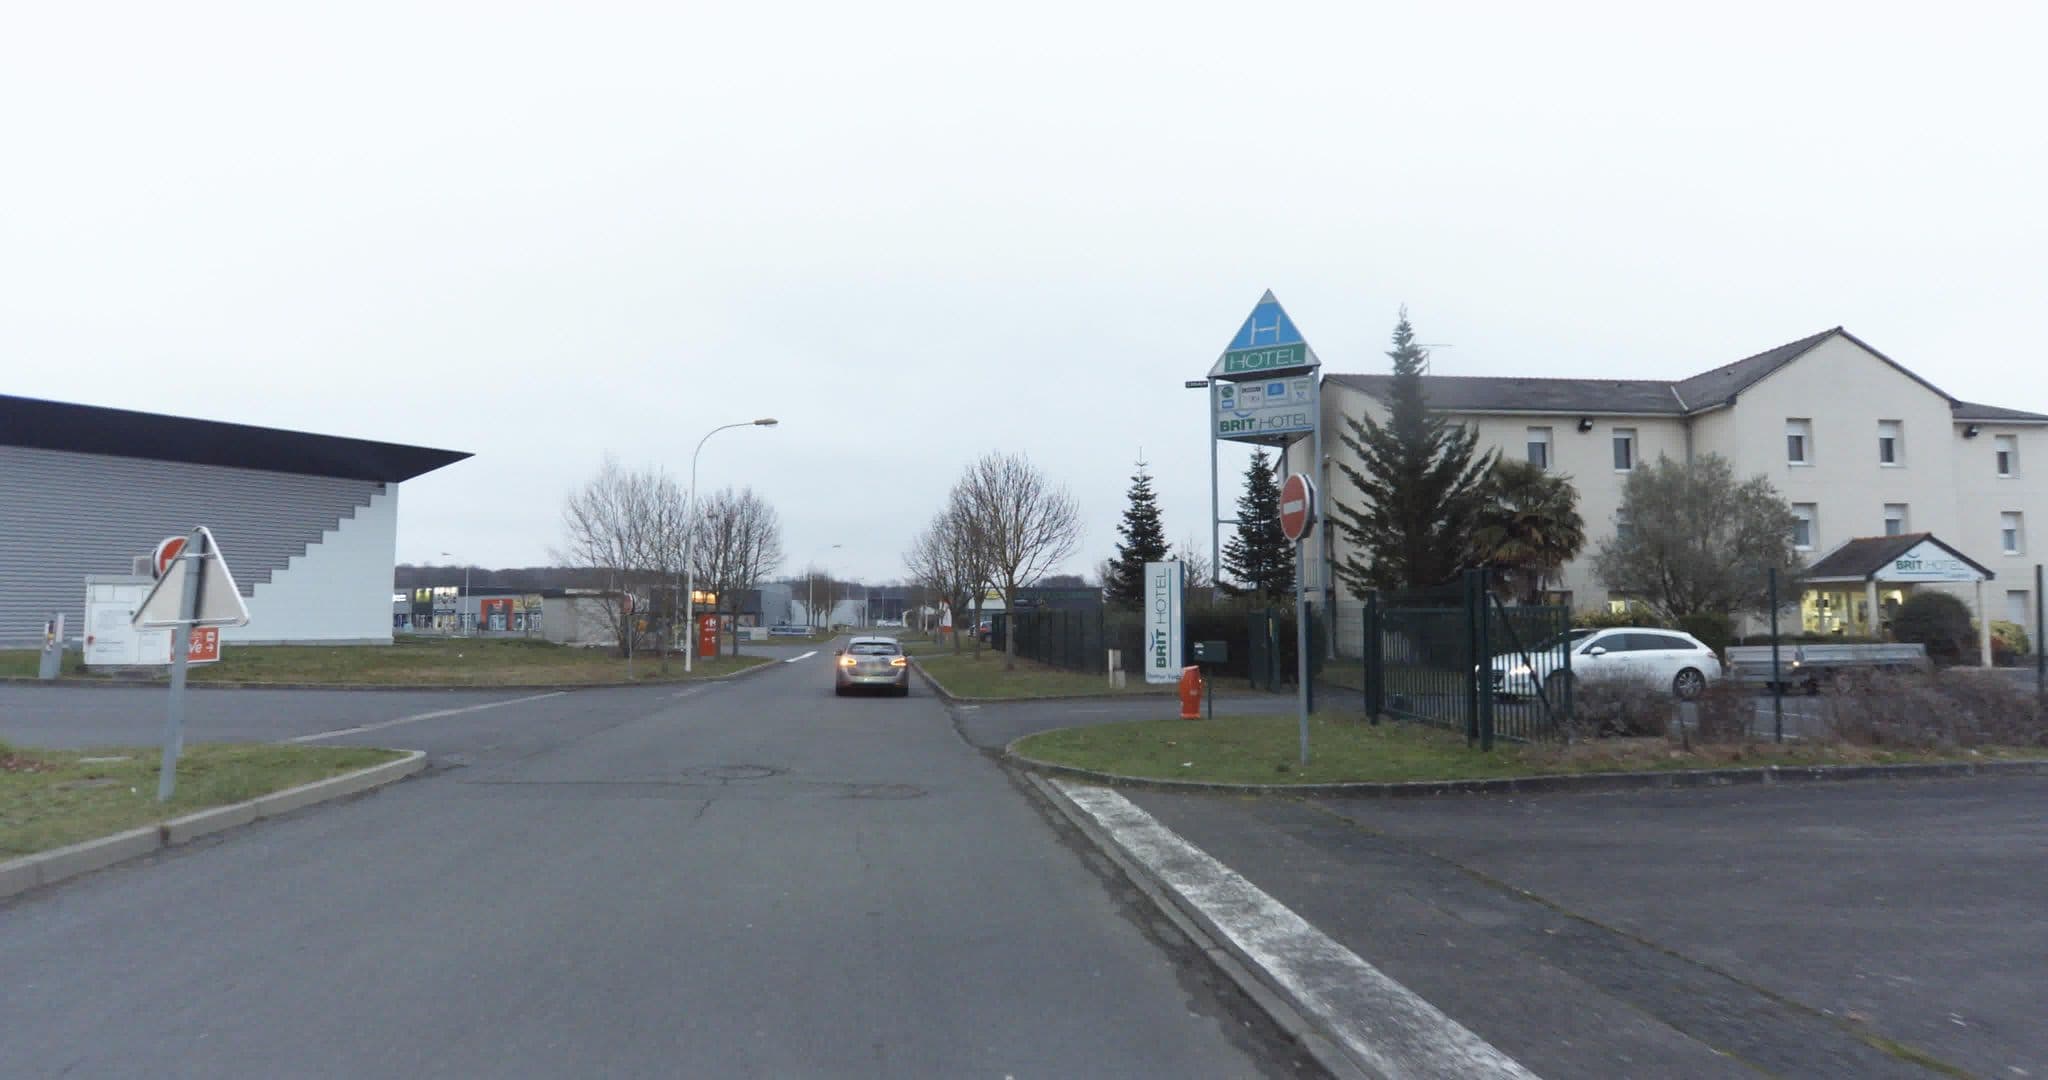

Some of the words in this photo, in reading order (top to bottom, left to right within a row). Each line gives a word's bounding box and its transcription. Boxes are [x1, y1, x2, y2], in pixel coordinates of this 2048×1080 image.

[1251, 315, 1280, 345] H
[1229, 348, 1302, 370] HOTEL
[1219, 418, 1256, 433] BRIT
[1259, 413, 1312, 429] HOTEL
[1895, 560, 1923, 570] BRIT
[1156, 568, 1167, 625] HOTEL
[1156, 629, 1167, 669] BRIT
